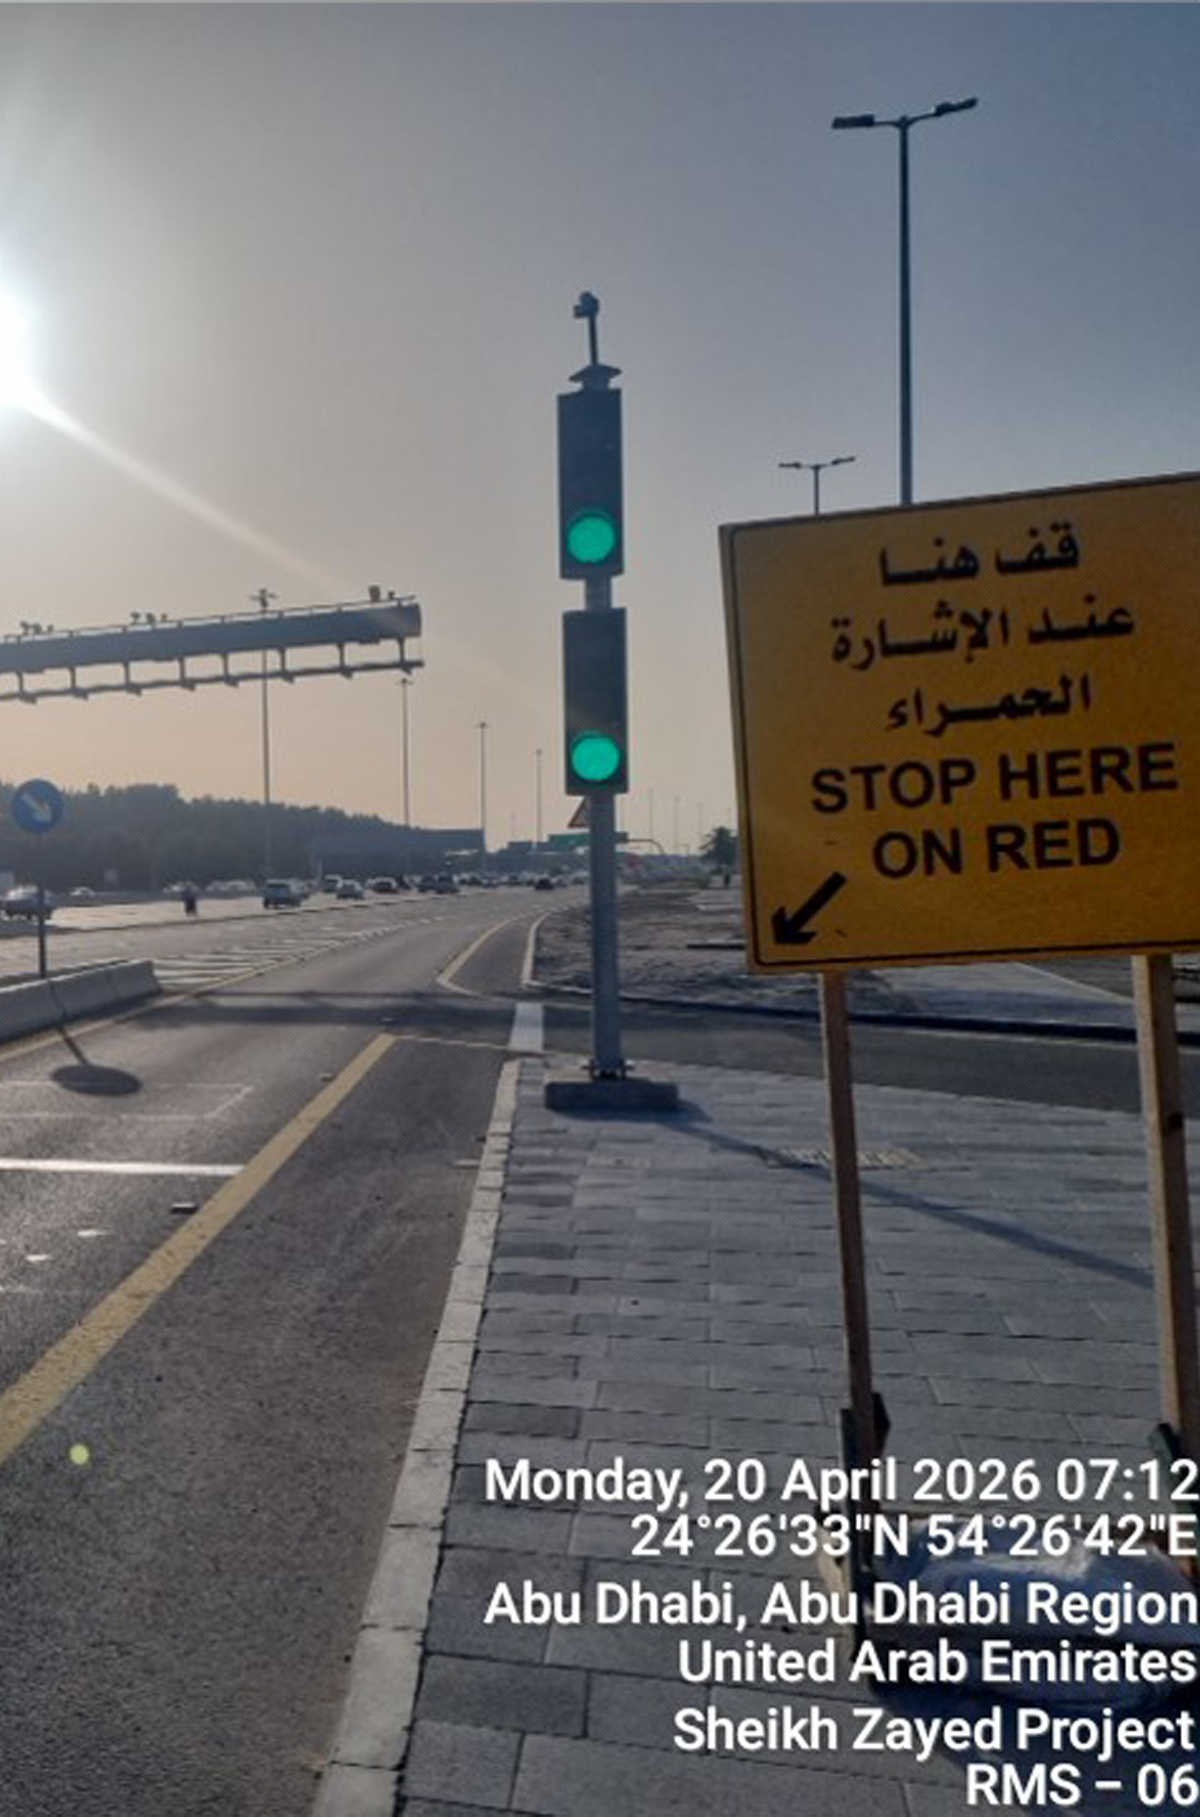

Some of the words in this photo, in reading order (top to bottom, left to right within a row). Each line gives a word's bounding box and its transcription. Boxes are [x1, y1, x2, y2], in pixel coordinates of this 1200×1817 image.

[877, 535, 983, 589] هنا
[993, 518, 1082, 577] قف
[829, 598, 1012, 673] الإشارة
[1026, 592, 1137, 646] عند
[887, 671, 1093, 739] الحمراء
[810, 756, 978, 815] STOP
[997, 738, 1181, 802] HERE
[871, 826, 965, 881] ON
[984, 815, 1123, 874] RED
